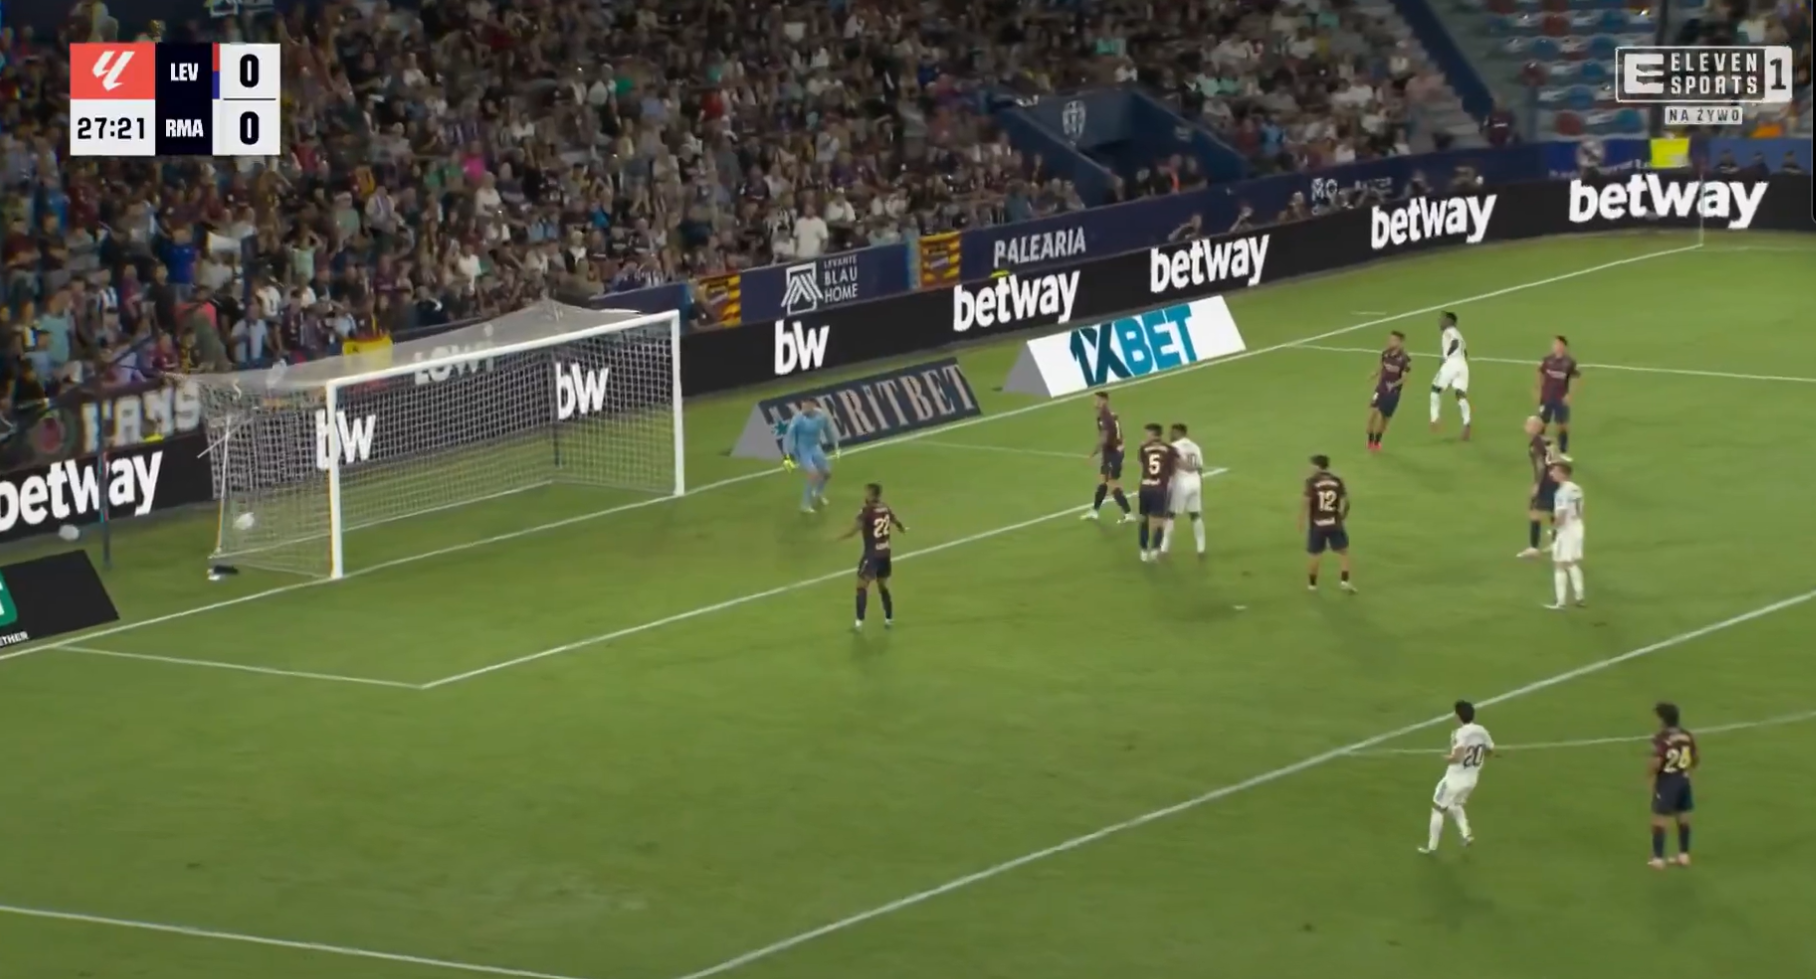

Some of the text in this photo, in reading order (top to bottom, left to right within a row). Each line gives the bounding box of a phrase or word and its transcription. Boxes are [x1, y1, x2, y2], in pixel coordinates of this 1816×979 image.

[1371, 193, 1497, 249] betway
[1569, 173, 1768, 229] betway
[824, 266, 858, 286] BLAU
[1150, 233, 1270, 294] betway
[824, 283, 858, 303] HOME
[953, 270, 1080, 332] betway
[774, 319, 829, 375] bw
[1070, 303, 1197, 389] 1XBET
[555, 362, 609, 420] bw
[1149, 453, 1160, 475] 5
[1318, 490, 1337, 511] 12
[1463, 743, 1487, 769] 20
